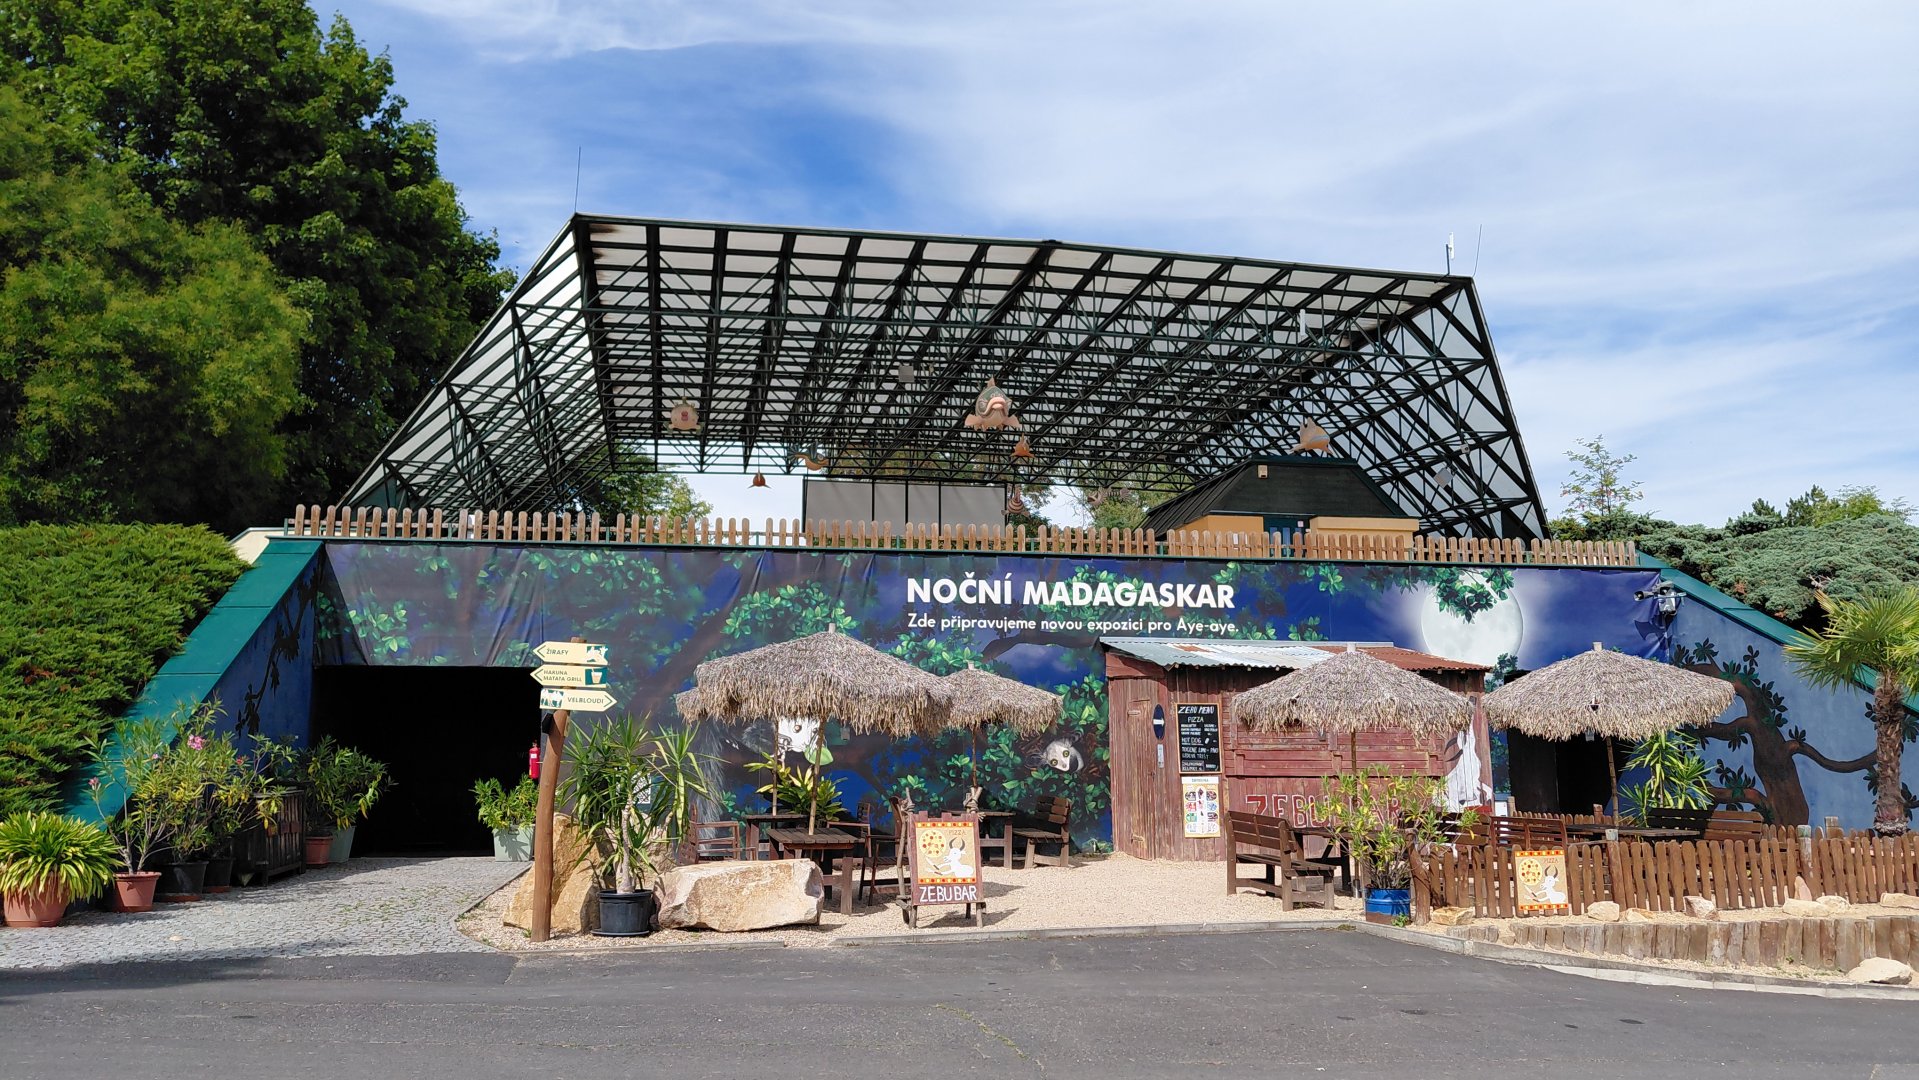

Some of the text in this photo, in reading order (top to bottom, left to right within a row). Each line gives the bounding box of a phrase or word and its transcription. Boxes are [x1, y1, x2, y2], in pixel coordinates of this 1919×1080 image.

[907, 572, 1235, 608] NOČNÍ MADAGASKAR
[908, 613, 1239, 636] Zde připravujeme novou expozici pro Aye-aye.
